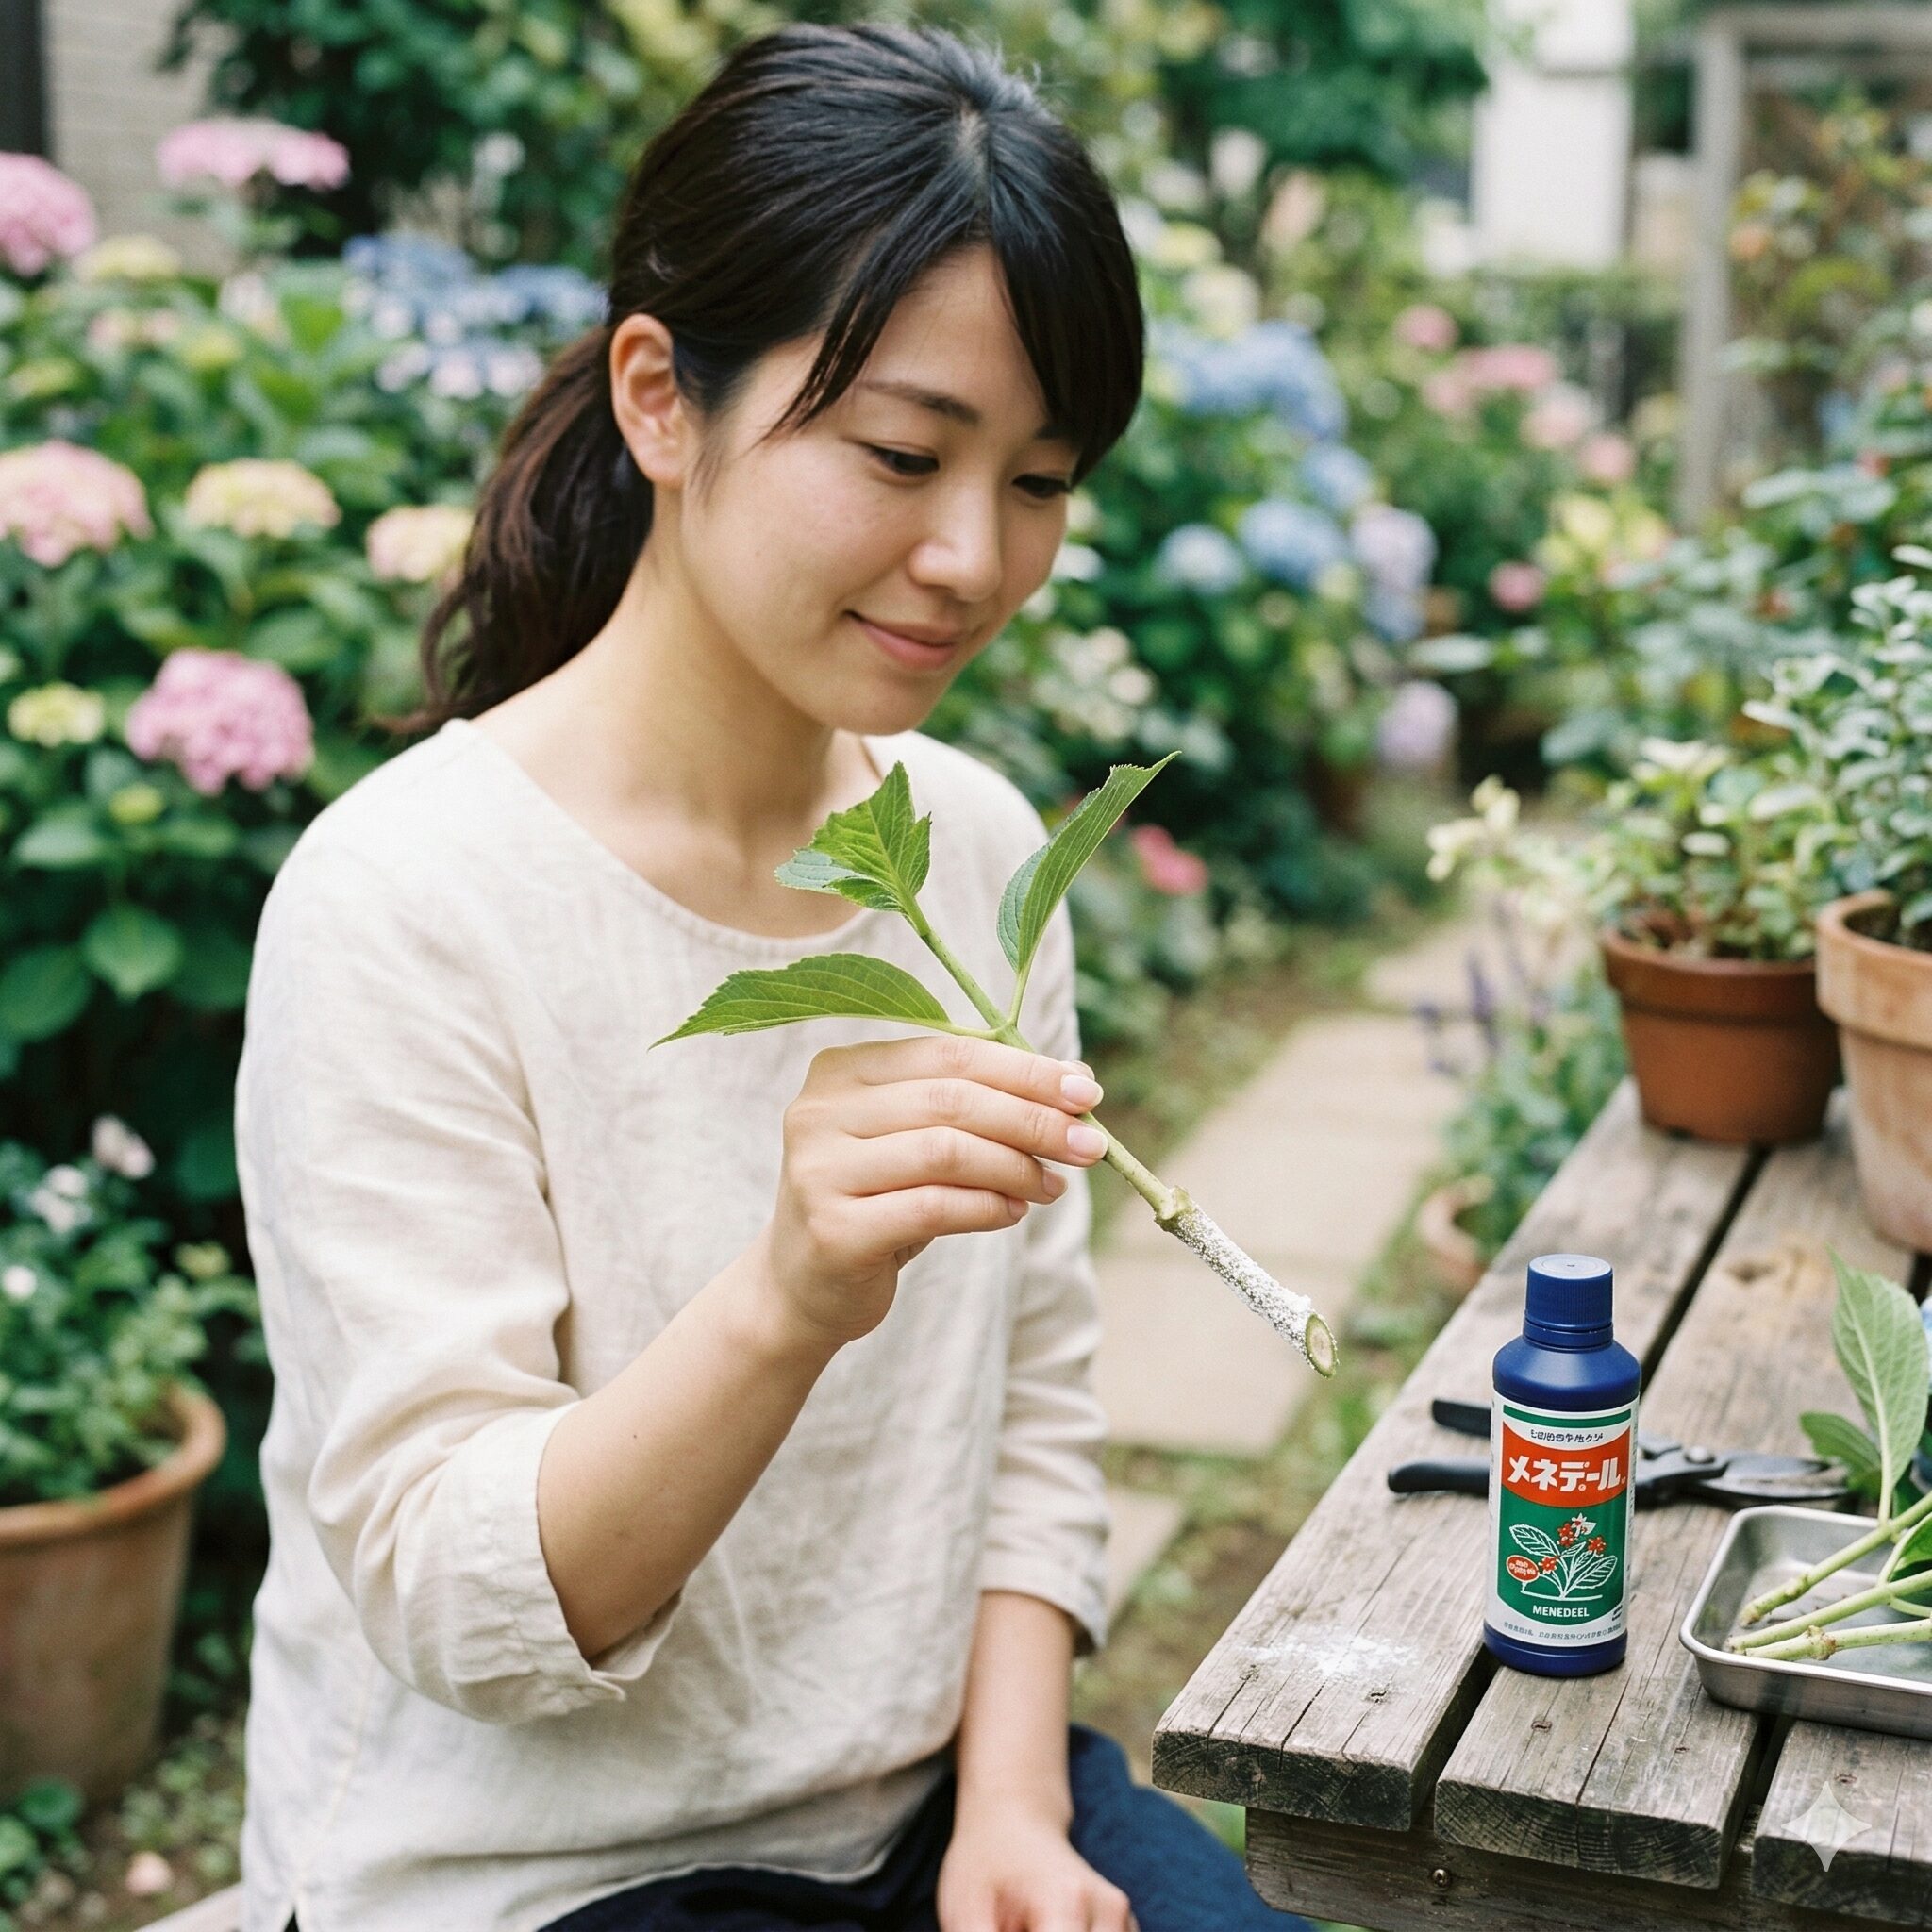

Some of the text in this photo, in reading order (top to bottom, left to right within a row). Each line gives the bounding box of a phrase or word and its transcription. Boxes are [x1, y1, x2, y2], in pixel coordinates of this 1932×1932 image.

[1507, 1455, 1621, 1492] メネデール
[1532, 1605, 1590, 1618] MENEDEEL
